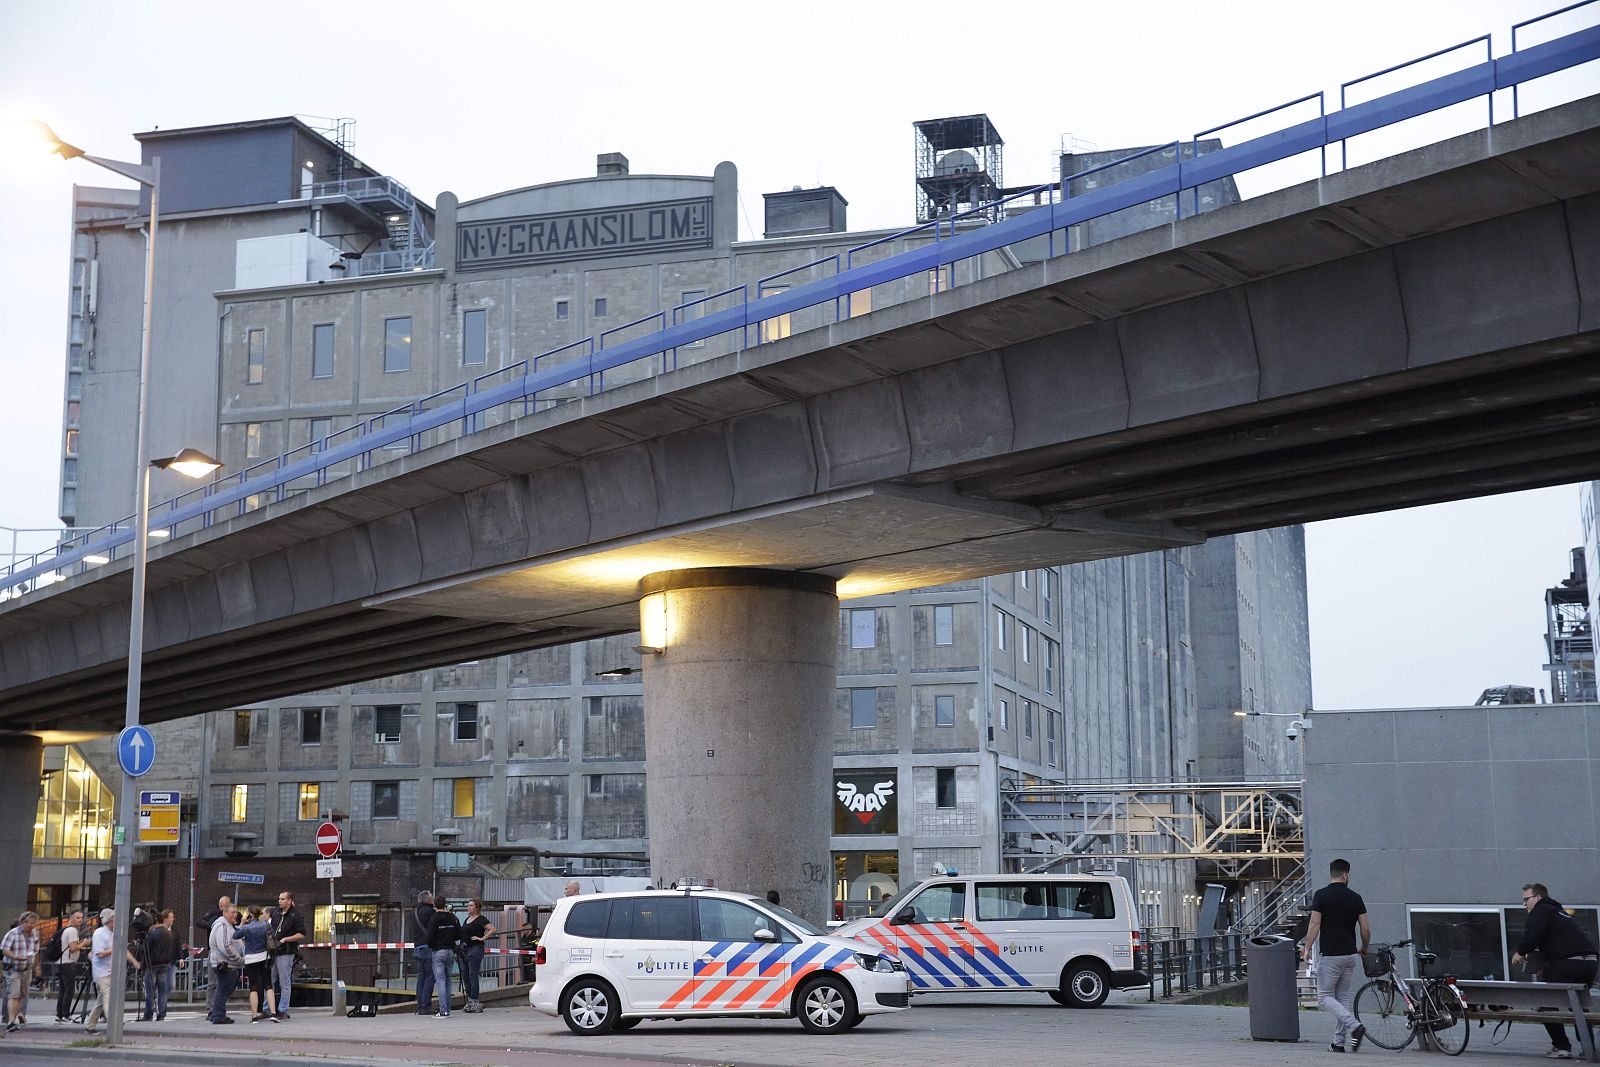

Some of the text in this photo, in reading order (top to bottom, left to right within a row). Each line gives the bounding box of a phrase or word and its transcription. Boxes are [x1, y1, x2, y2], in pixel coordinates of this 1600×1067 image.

[837, 780, 894, 812] RAAF
[1003, 944, 1044, 955] POLITIE
[637, 959, 689, 974] POLITIE
